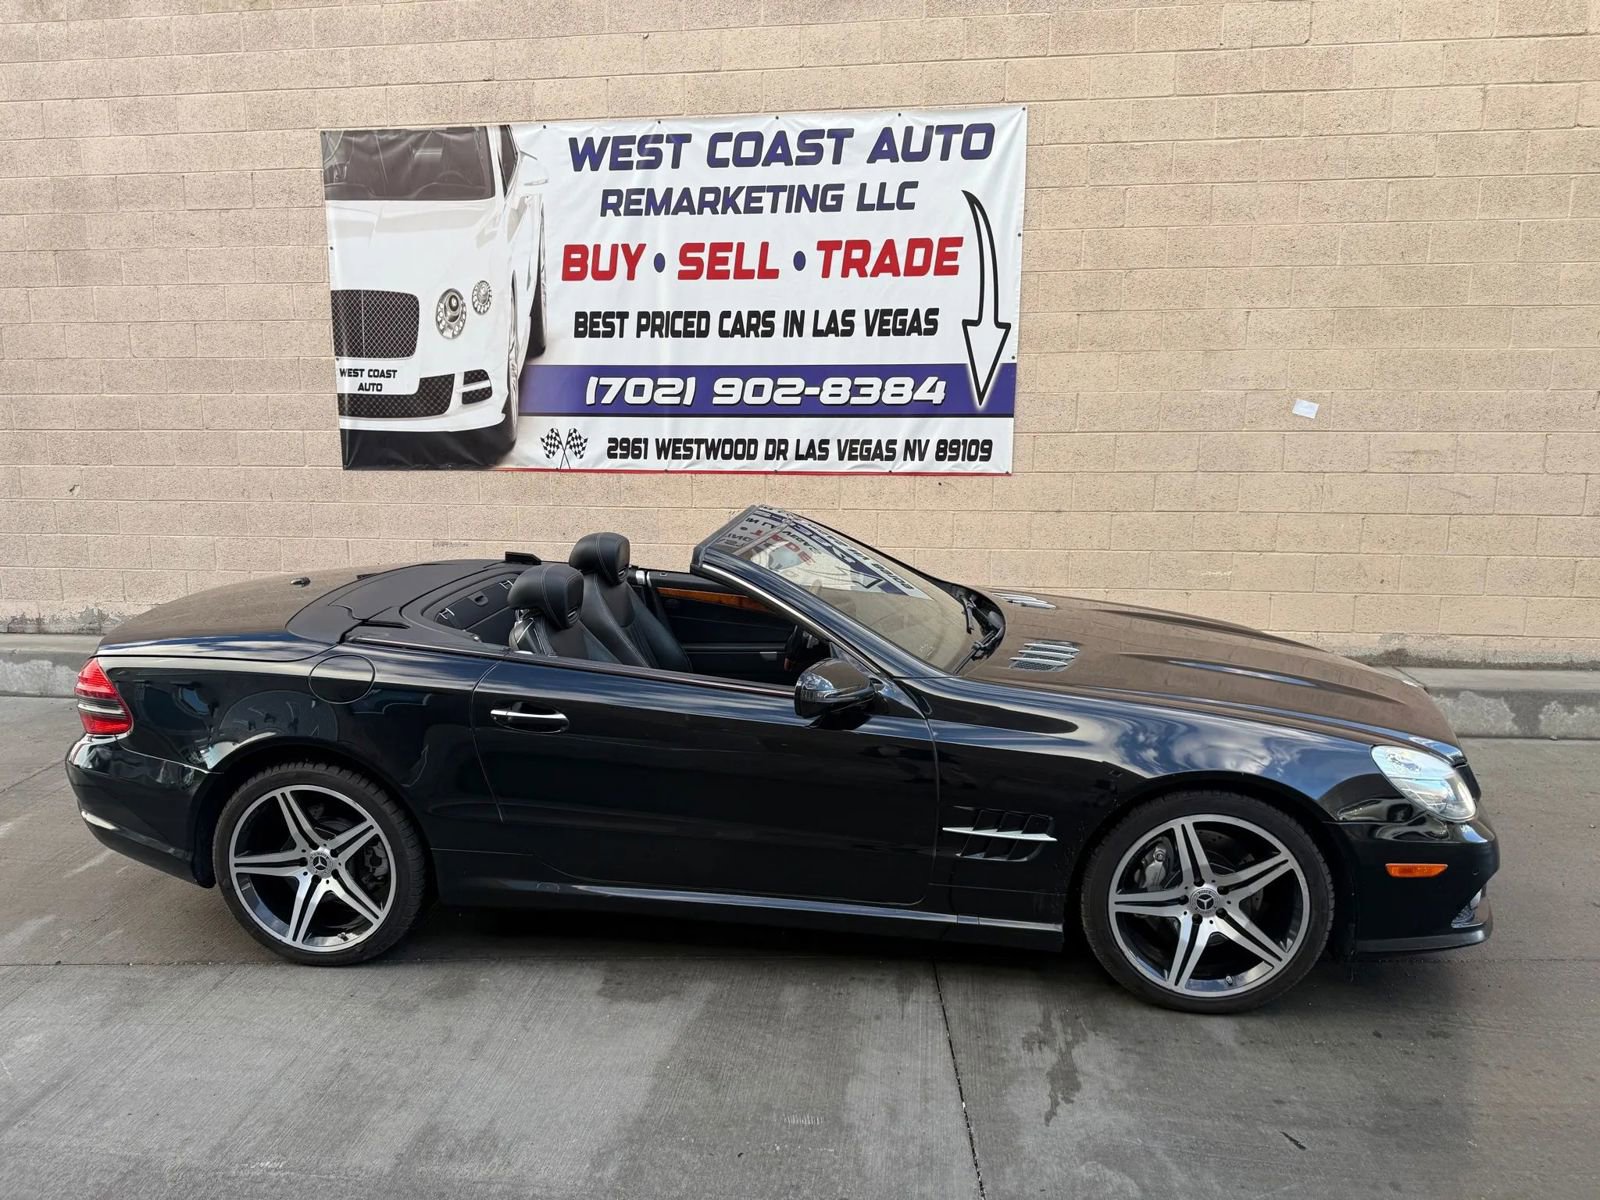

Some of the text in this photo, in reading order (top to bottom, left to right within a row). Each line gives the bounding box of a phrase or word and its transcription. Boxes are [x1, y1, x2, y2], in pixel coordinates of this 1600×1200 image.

[568, 122, 996, 172] WEST COAST AUTO
[600, 181, 919, 217] REMARKETING LLC
[561, 236, 964, 281] BUY SELL TRADE
[573, 307, 940, 339] BEST PRICED CARS IN LAS VEGAS
[339, 368, 398, 379] WEST COAST
[357, 382, 383, 392] AUTO
[585, 376, 947, 406] (702) 902-8384
[606, 437, 994, 462] 2961 WESTWOOD DR LAS VEGAS NV 89109
